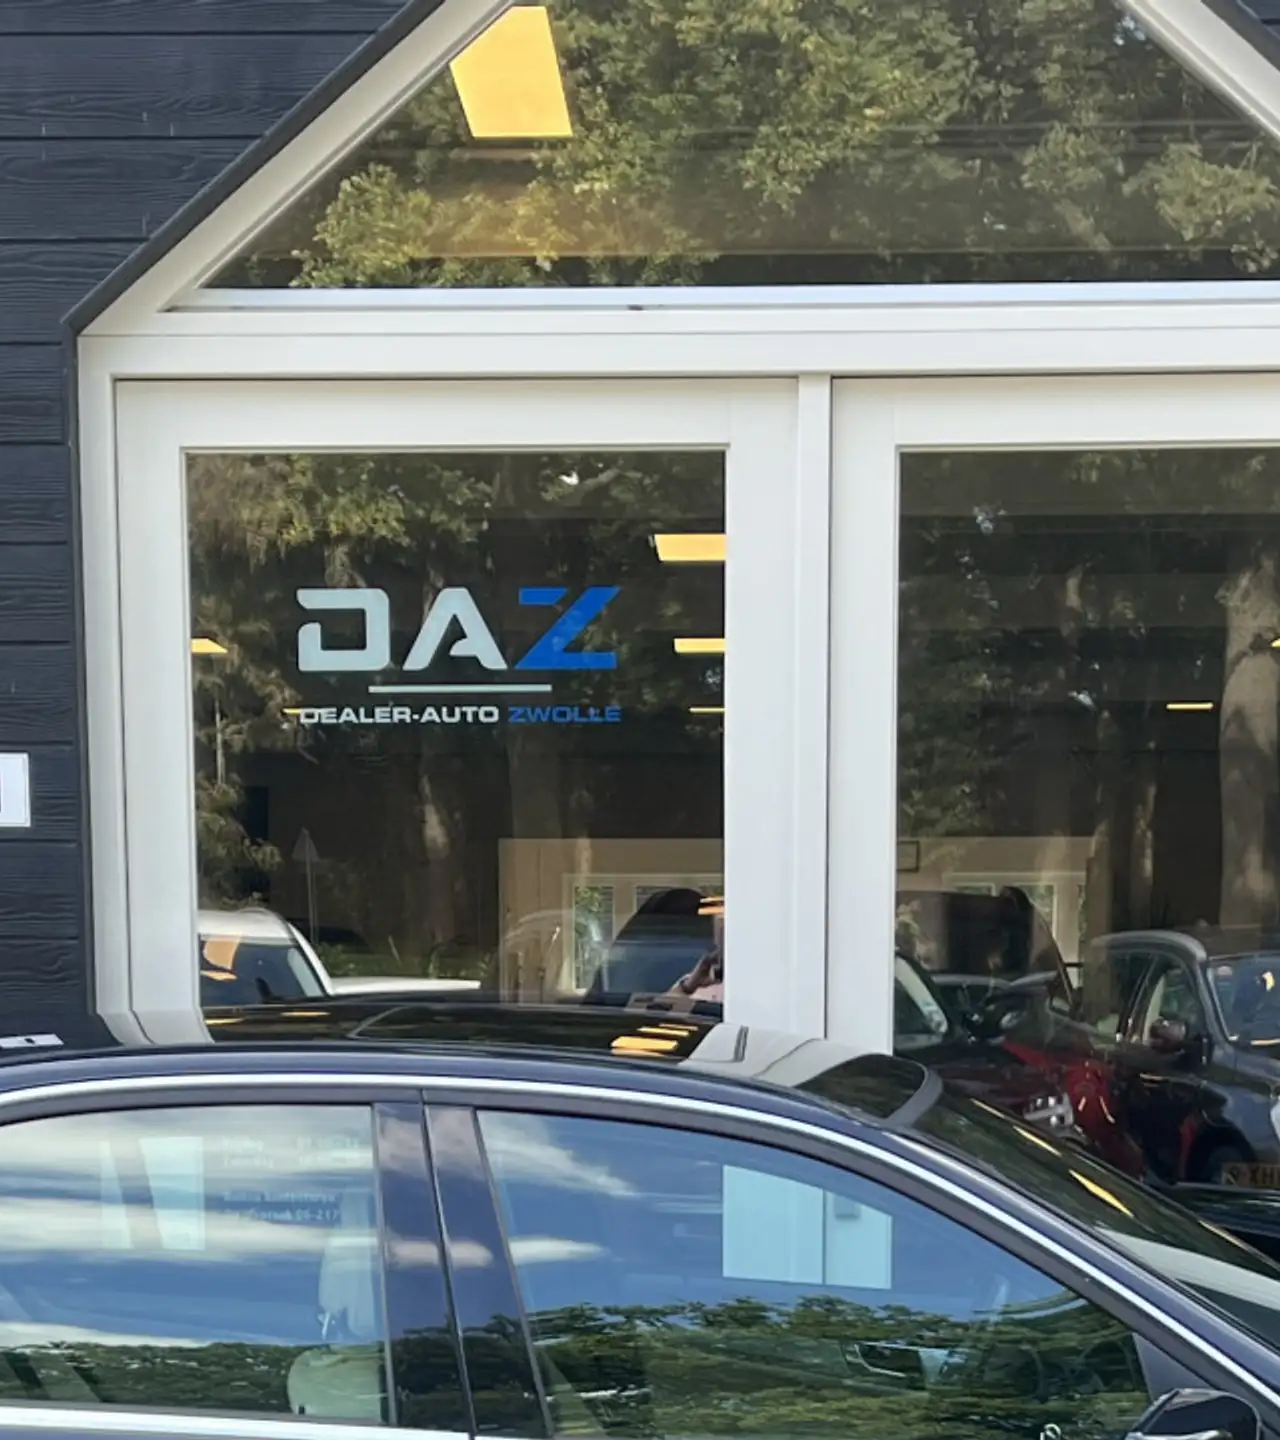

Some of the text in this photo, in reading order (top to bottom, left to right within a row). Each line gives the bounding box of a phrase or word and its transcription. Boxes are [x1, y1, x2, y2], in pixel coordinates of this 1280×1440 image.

[296, 586, 620, 671] DAZ
[299, 706, 621, 724] DEALER-AUTO ZWOLLE
